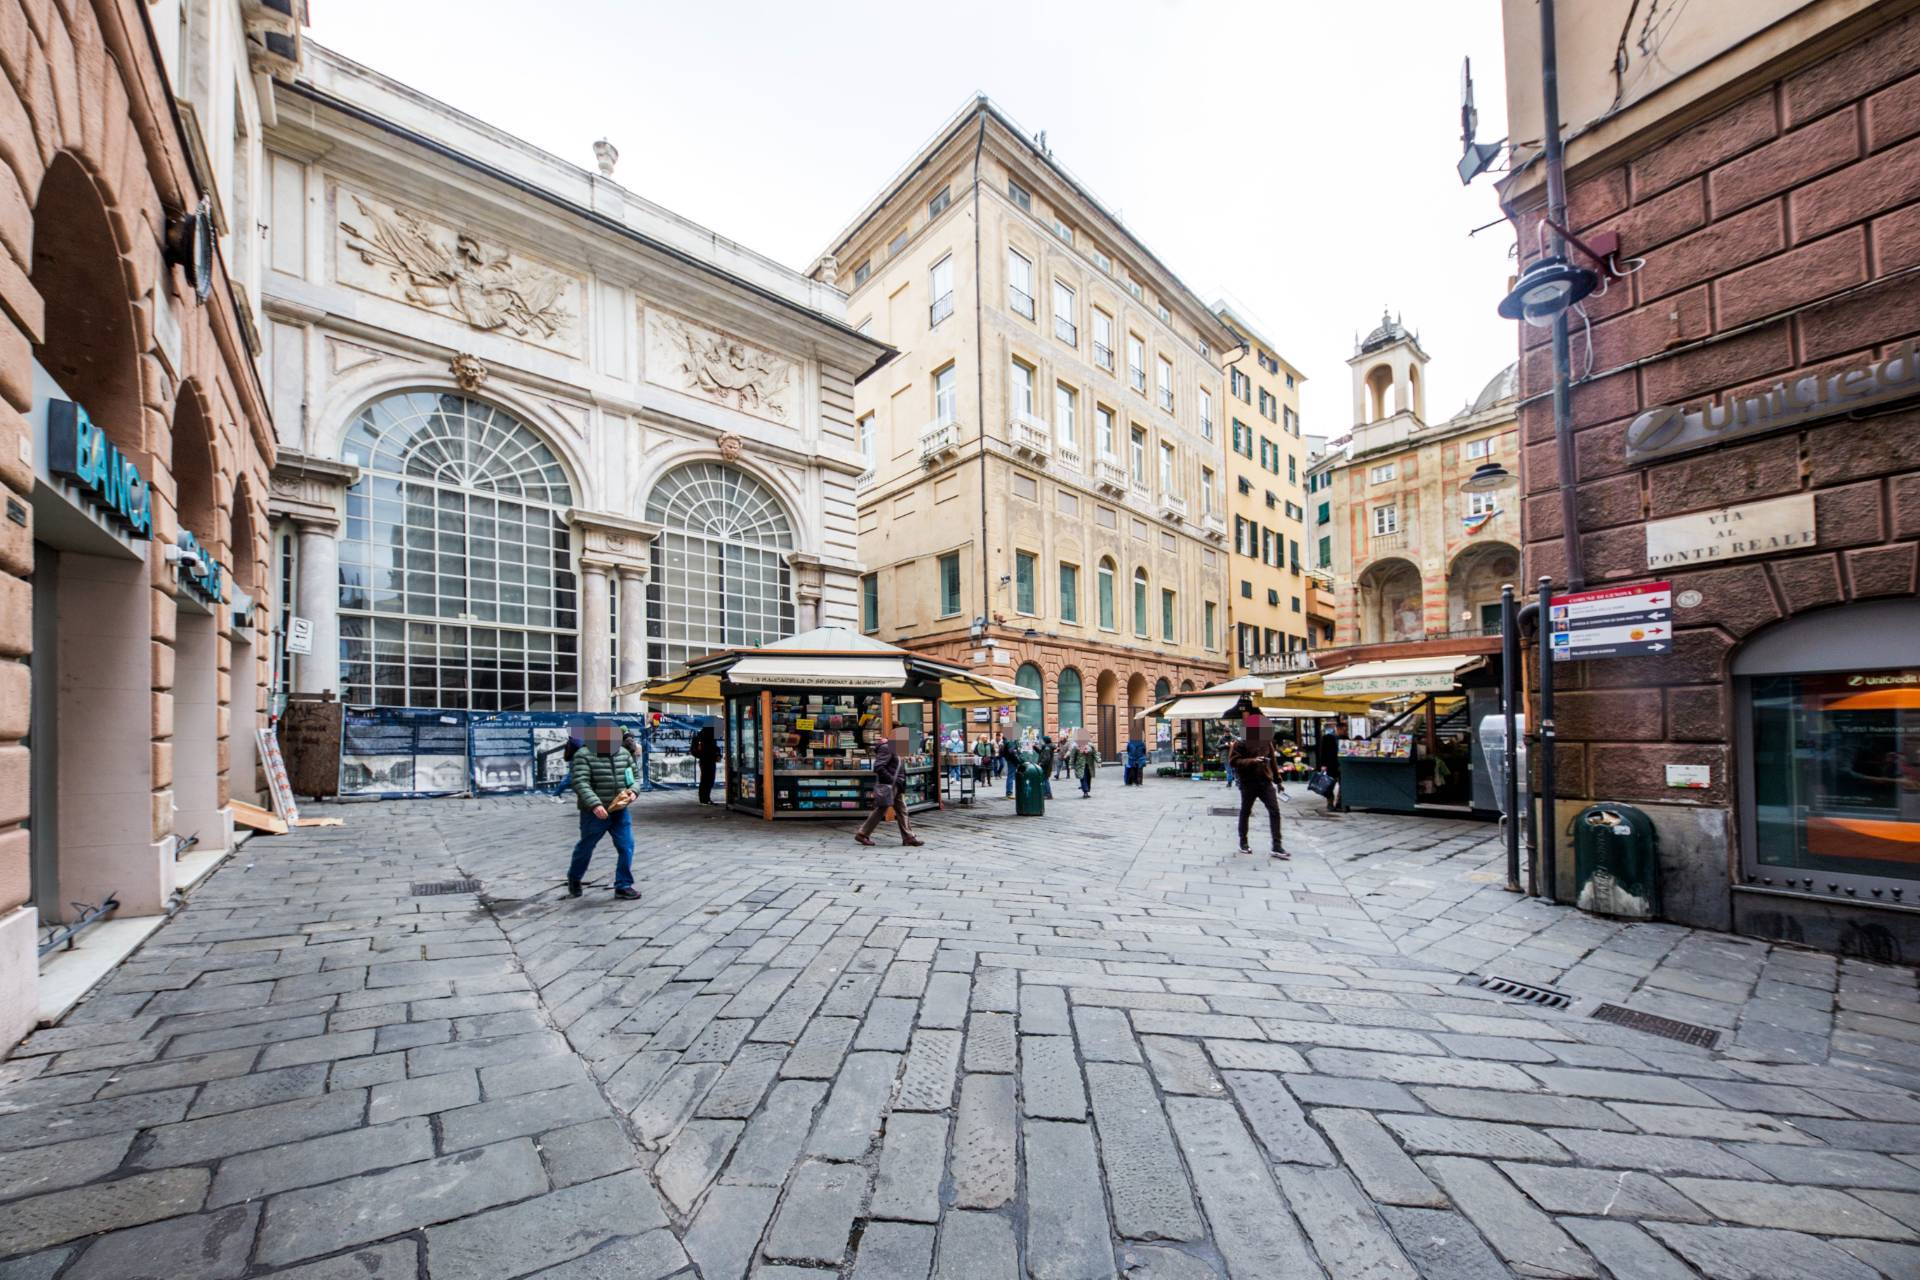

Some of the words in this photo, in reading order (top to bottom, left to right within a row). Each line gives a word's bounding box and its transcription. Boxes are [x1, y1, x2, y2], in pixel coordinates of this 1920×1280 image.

[75, 401, 153, 541] BANCA
[1708, 510, 1745, 526] VIA
[1715, 529, 1737, 539] AL
[1650, 544, 1721, 566] PONTE
[1731, 530, 1817, 553] REALE
[1865, 674, 1918, 685] UniCredit
